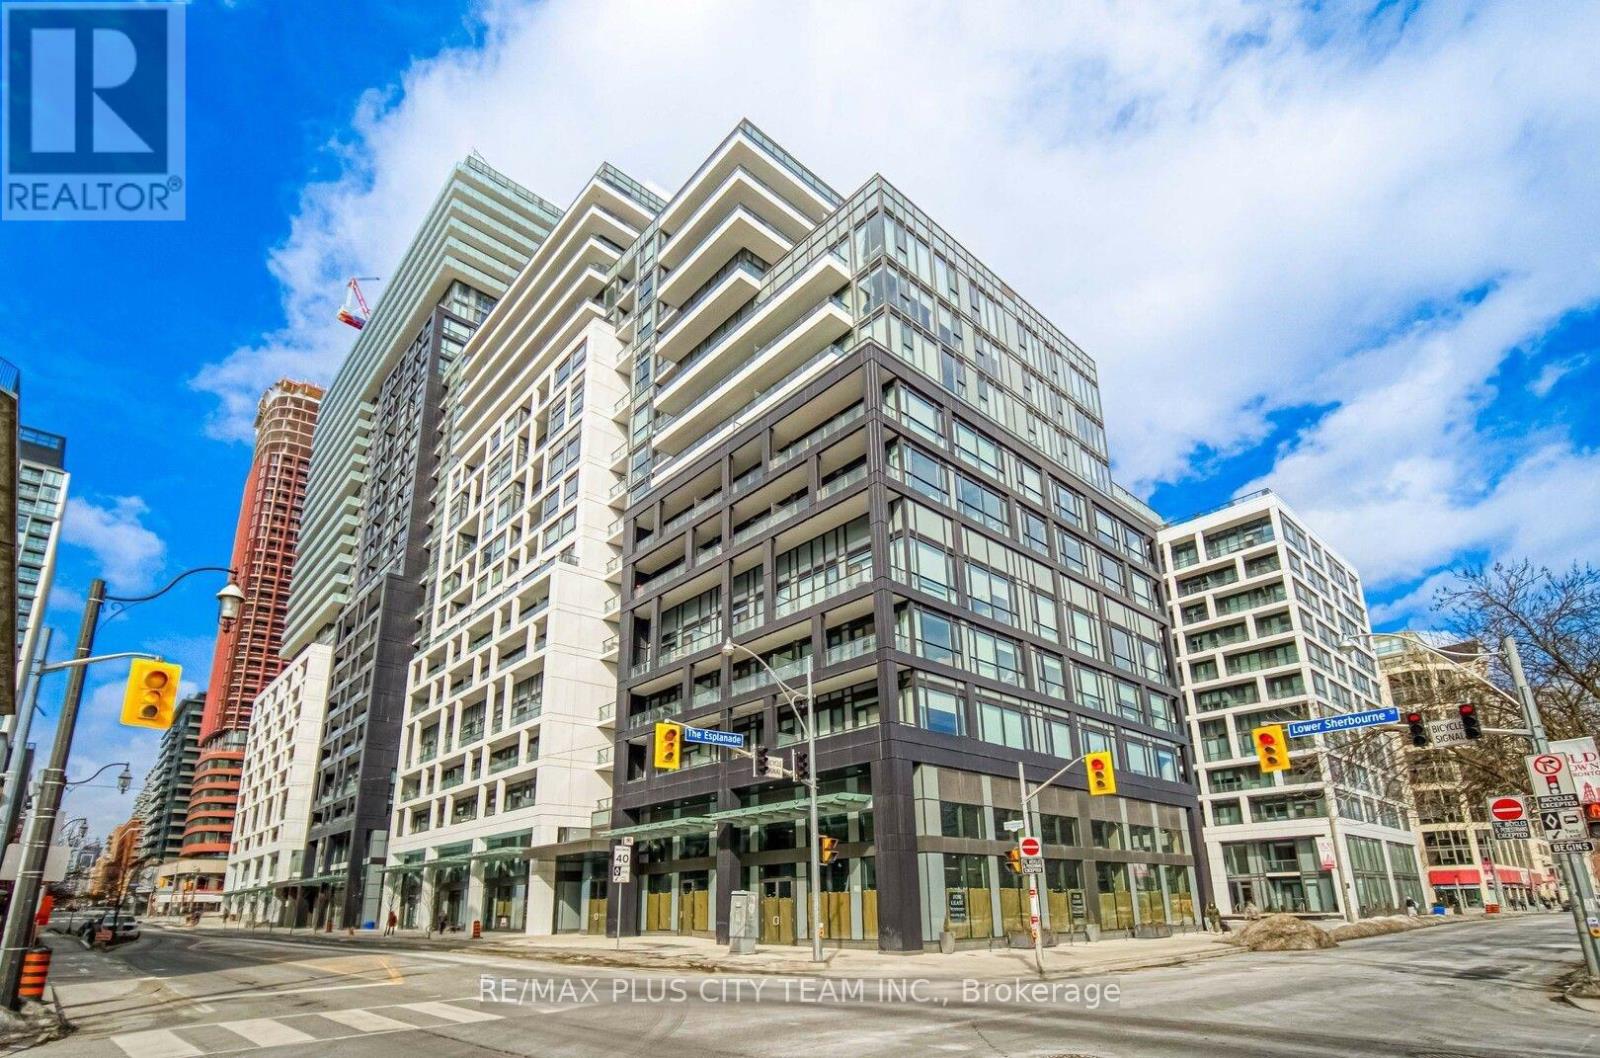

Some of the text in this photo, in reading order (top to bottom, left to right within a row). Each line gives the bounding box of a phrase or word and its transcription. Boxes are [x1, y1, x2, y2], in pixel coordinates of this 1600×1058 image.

[1292, 722, 1321, 734] Lower
[1325, 712, 1386, 729] Sherbourne
[1432, 721, 1465, 733] BICYCLE
[687, 728, 742, 744] The Esplanade
[1436, 732, 1465, 743] SIGNAL
[1569, 752, 1597, 764] LD
[1570, 761, 1600, 772] OWN
[1541, 800, 1578, 809] EXCEPTED
[1553, 843, 1590, 853] BEGINS
[616, 854, 629, 863] 40
